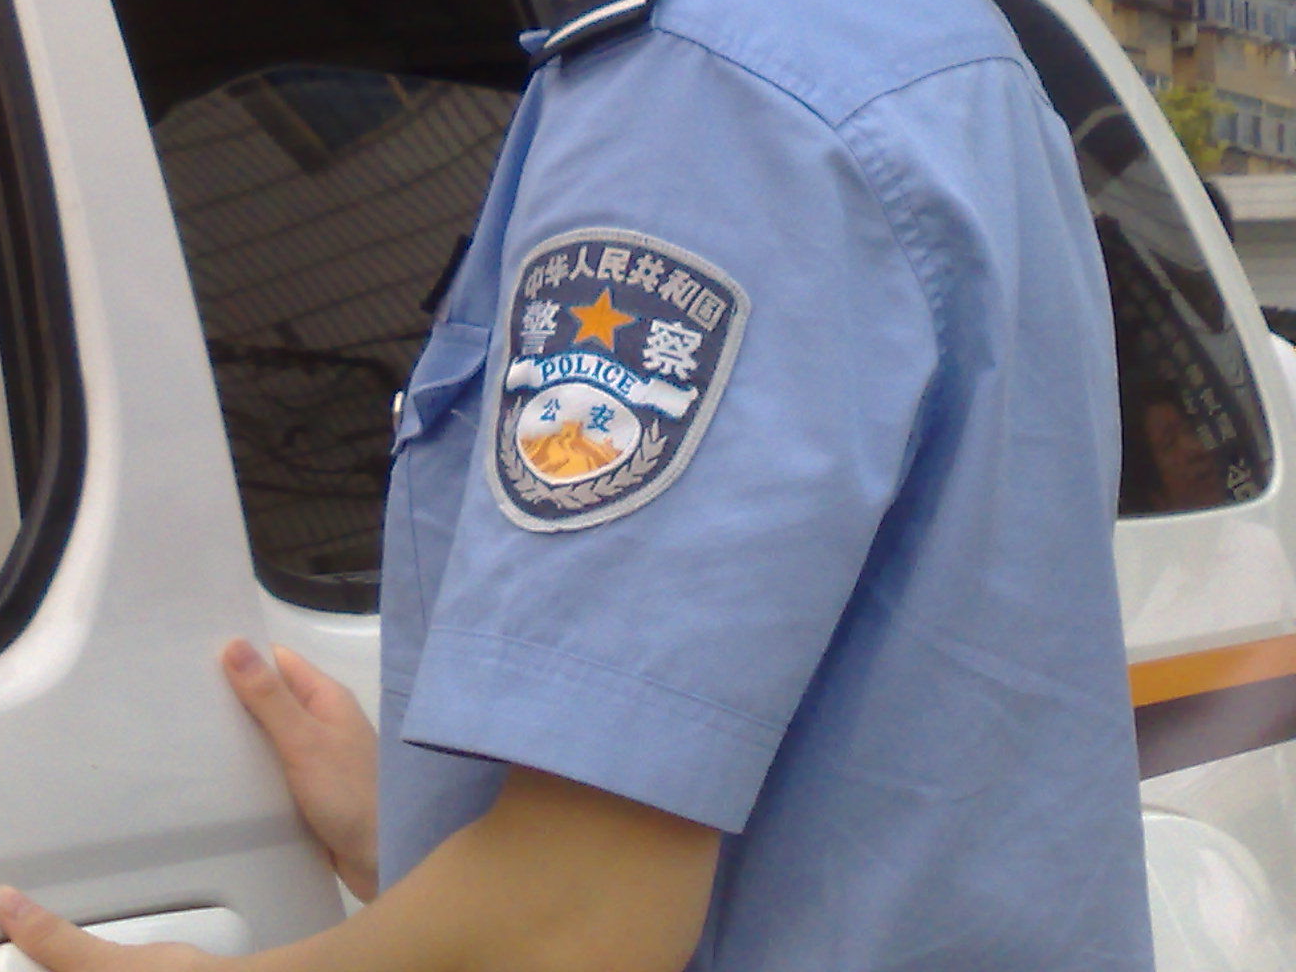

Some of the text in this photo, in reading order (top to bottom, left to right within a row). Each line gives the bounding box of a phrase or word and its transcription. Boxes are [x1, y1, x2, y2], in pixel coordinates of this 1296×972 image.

[524, 245, 728, 332] 中华人民共和国
[540, 353, 642, 397] POLICE
